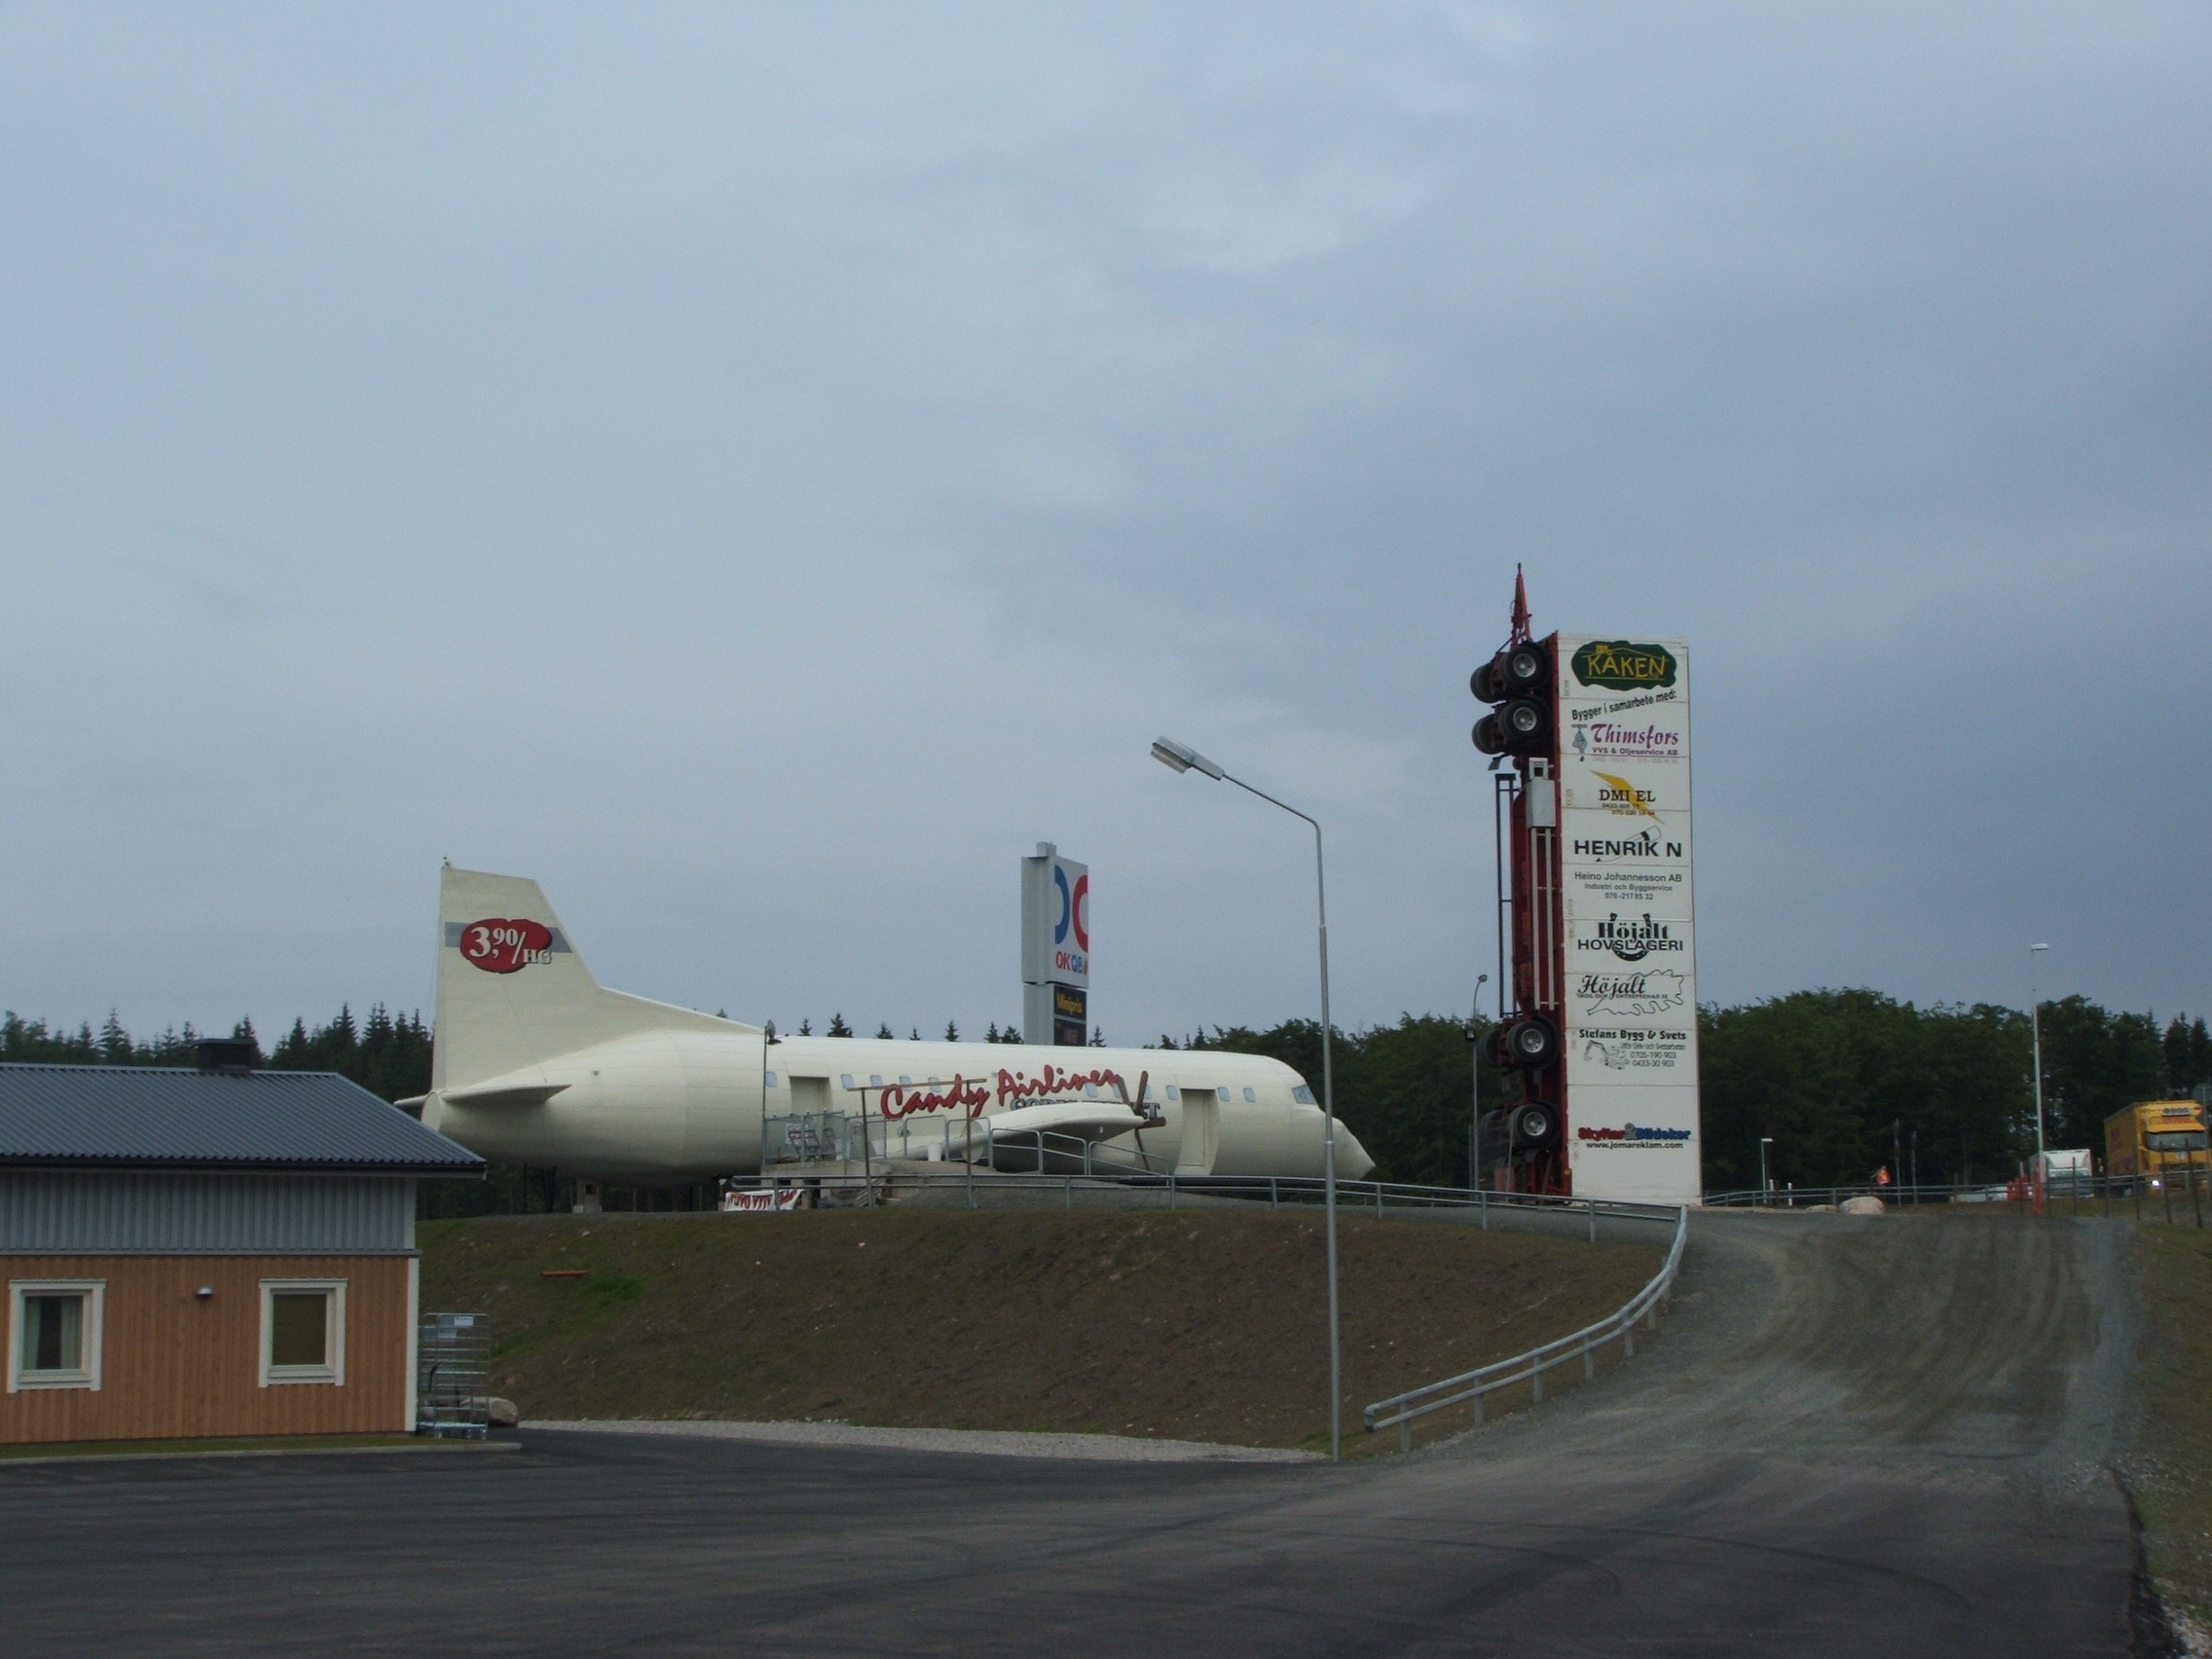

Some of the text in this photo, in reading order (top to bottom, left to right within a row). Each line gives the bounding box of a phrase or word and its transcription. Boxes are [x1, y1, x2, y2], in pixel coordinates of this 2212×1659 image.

[1572, 706, 1603, 720] Bygger
[1609, 694, 1654, 713] samarbete
[1655, 688, 1677, 702] med:
[1591, 723, 1678, 749] Thimsfors
[1619, 748, 1665, 756] Oljeservice
[1600, 789, 1656, 802] DMI EL
[1574, 839, 1681, 857] HENRIK N
[1575, 872, 1602, 881] Heino
[1604, 872, 1666, 882] Johannesson
[1599, 922, 1669, 943] Höjalt
[1578, 940, 1683, 951] HOVSLAGERI
[1577, 976, 1645, 1000] Höjalt
[1579, 1029, 1686, 1042] Stefans Bygg & Svets
[880, 1073, 990, 1121] Candy
[998, 1064, 1122, 1106] Airliner
[1586, 1141, 1683, 1150] www.jomareklam.com
